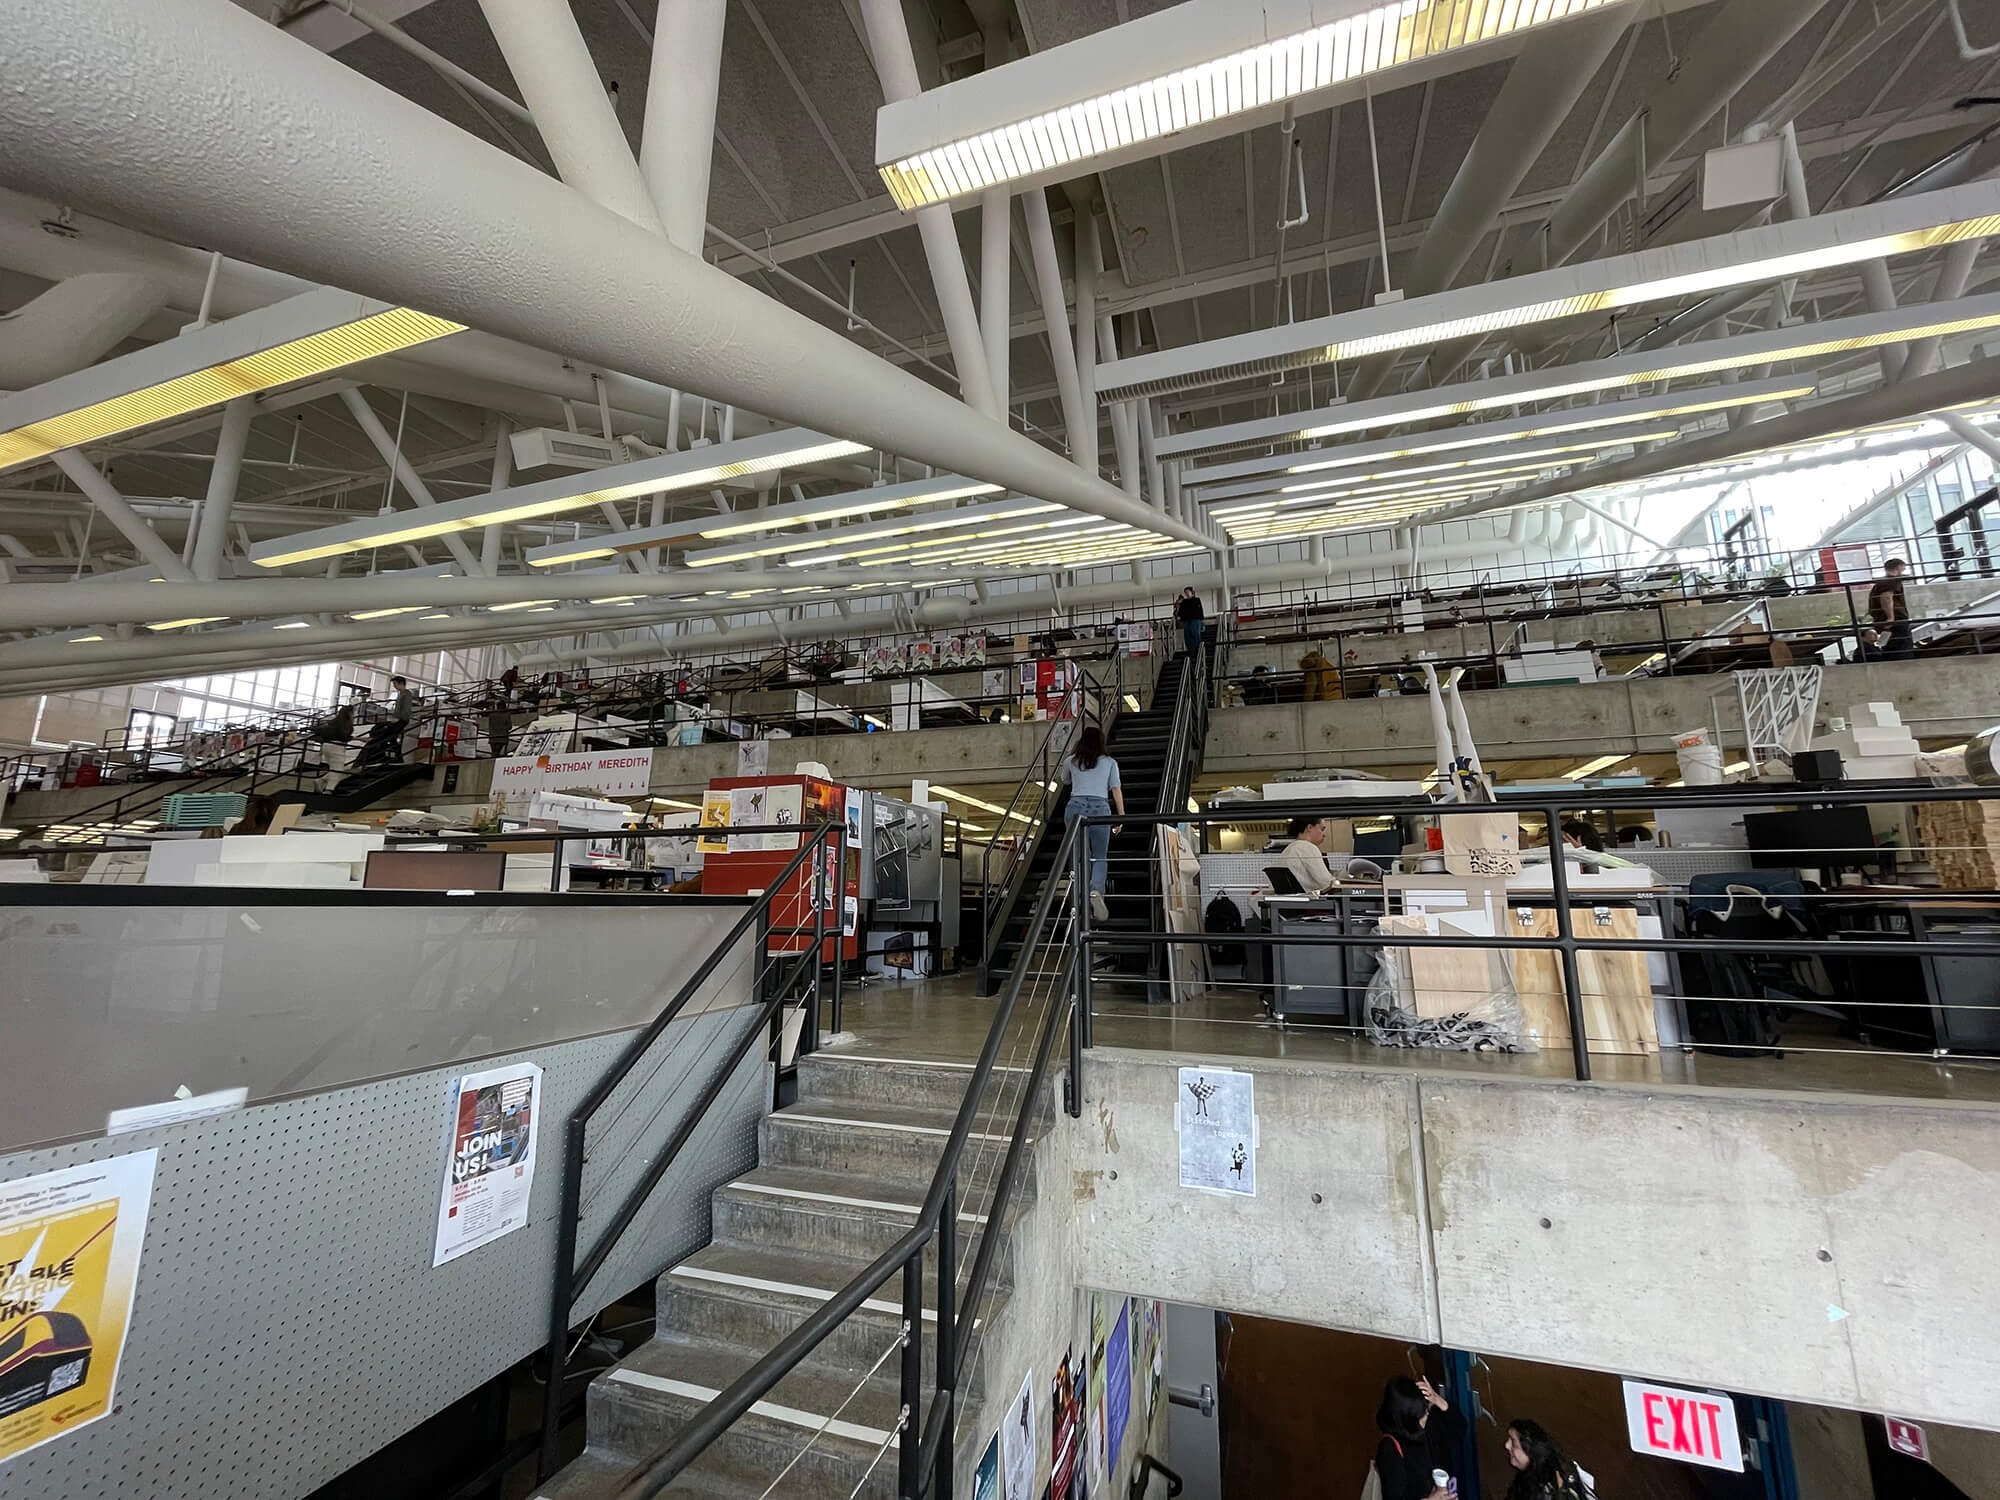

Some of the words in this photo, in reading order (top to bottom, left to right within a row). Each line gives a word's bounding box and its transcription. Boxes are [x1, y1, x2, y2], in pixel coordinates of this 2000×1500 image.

[502, 765, 534, 776] HAPPY
[544, 761, 593, 774] BIRTHDAY
[597, 756, 650, 770] MEREDITH
[457, 1129, 503, 1158] JOIN
[454, 1152, 489, 1179] US!
[1642, 1391, 1723, 1461] EXIT
